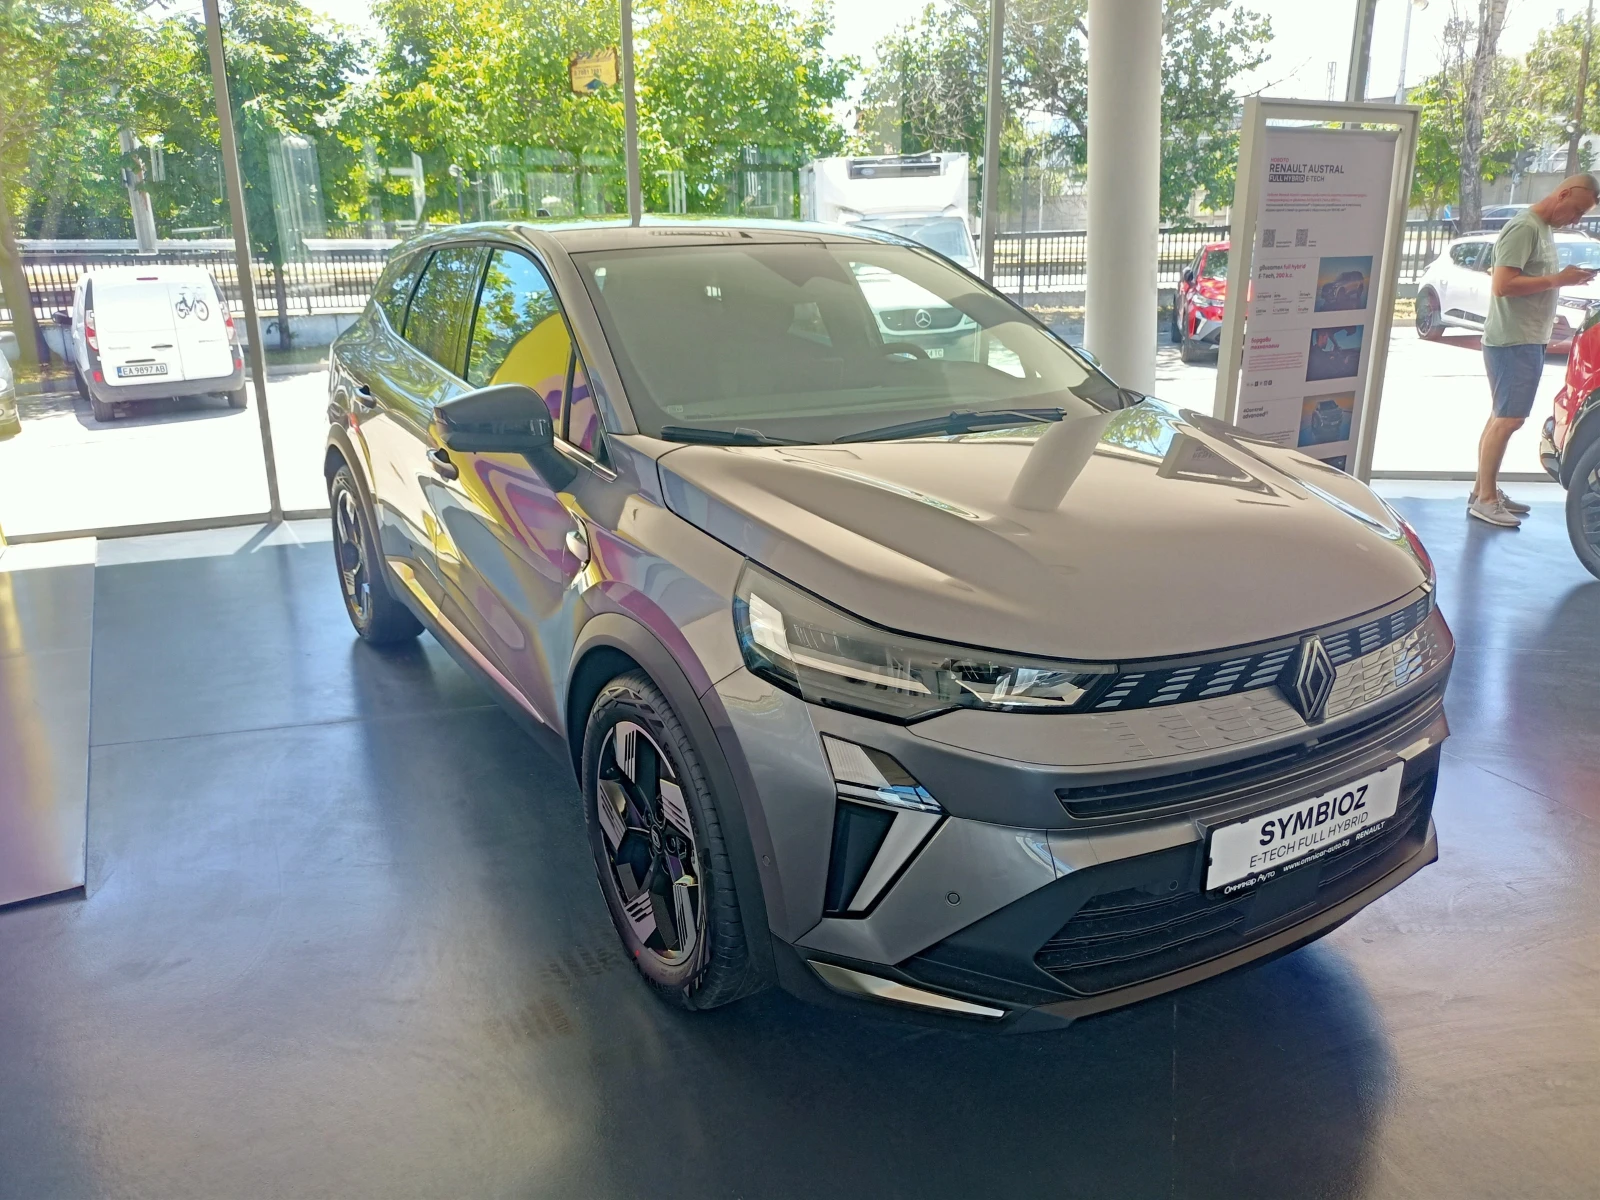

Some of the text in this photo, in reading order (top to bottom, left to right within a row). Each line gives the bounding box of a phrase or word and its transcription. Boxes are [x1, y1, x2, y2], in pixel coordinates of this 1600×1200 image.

[1269, 163, 1344, 174] RENAULT AUSTRAL
[122, 365, 166, 375] EA 9897 AB
[1249, 811, 1368, 868] E-TECH FULL HYBRID
[1259, 784, 1368, 846] SYMBIOZ
[1283, 820, 1386, 872] www.omnicar-auto.bg RENAULT
